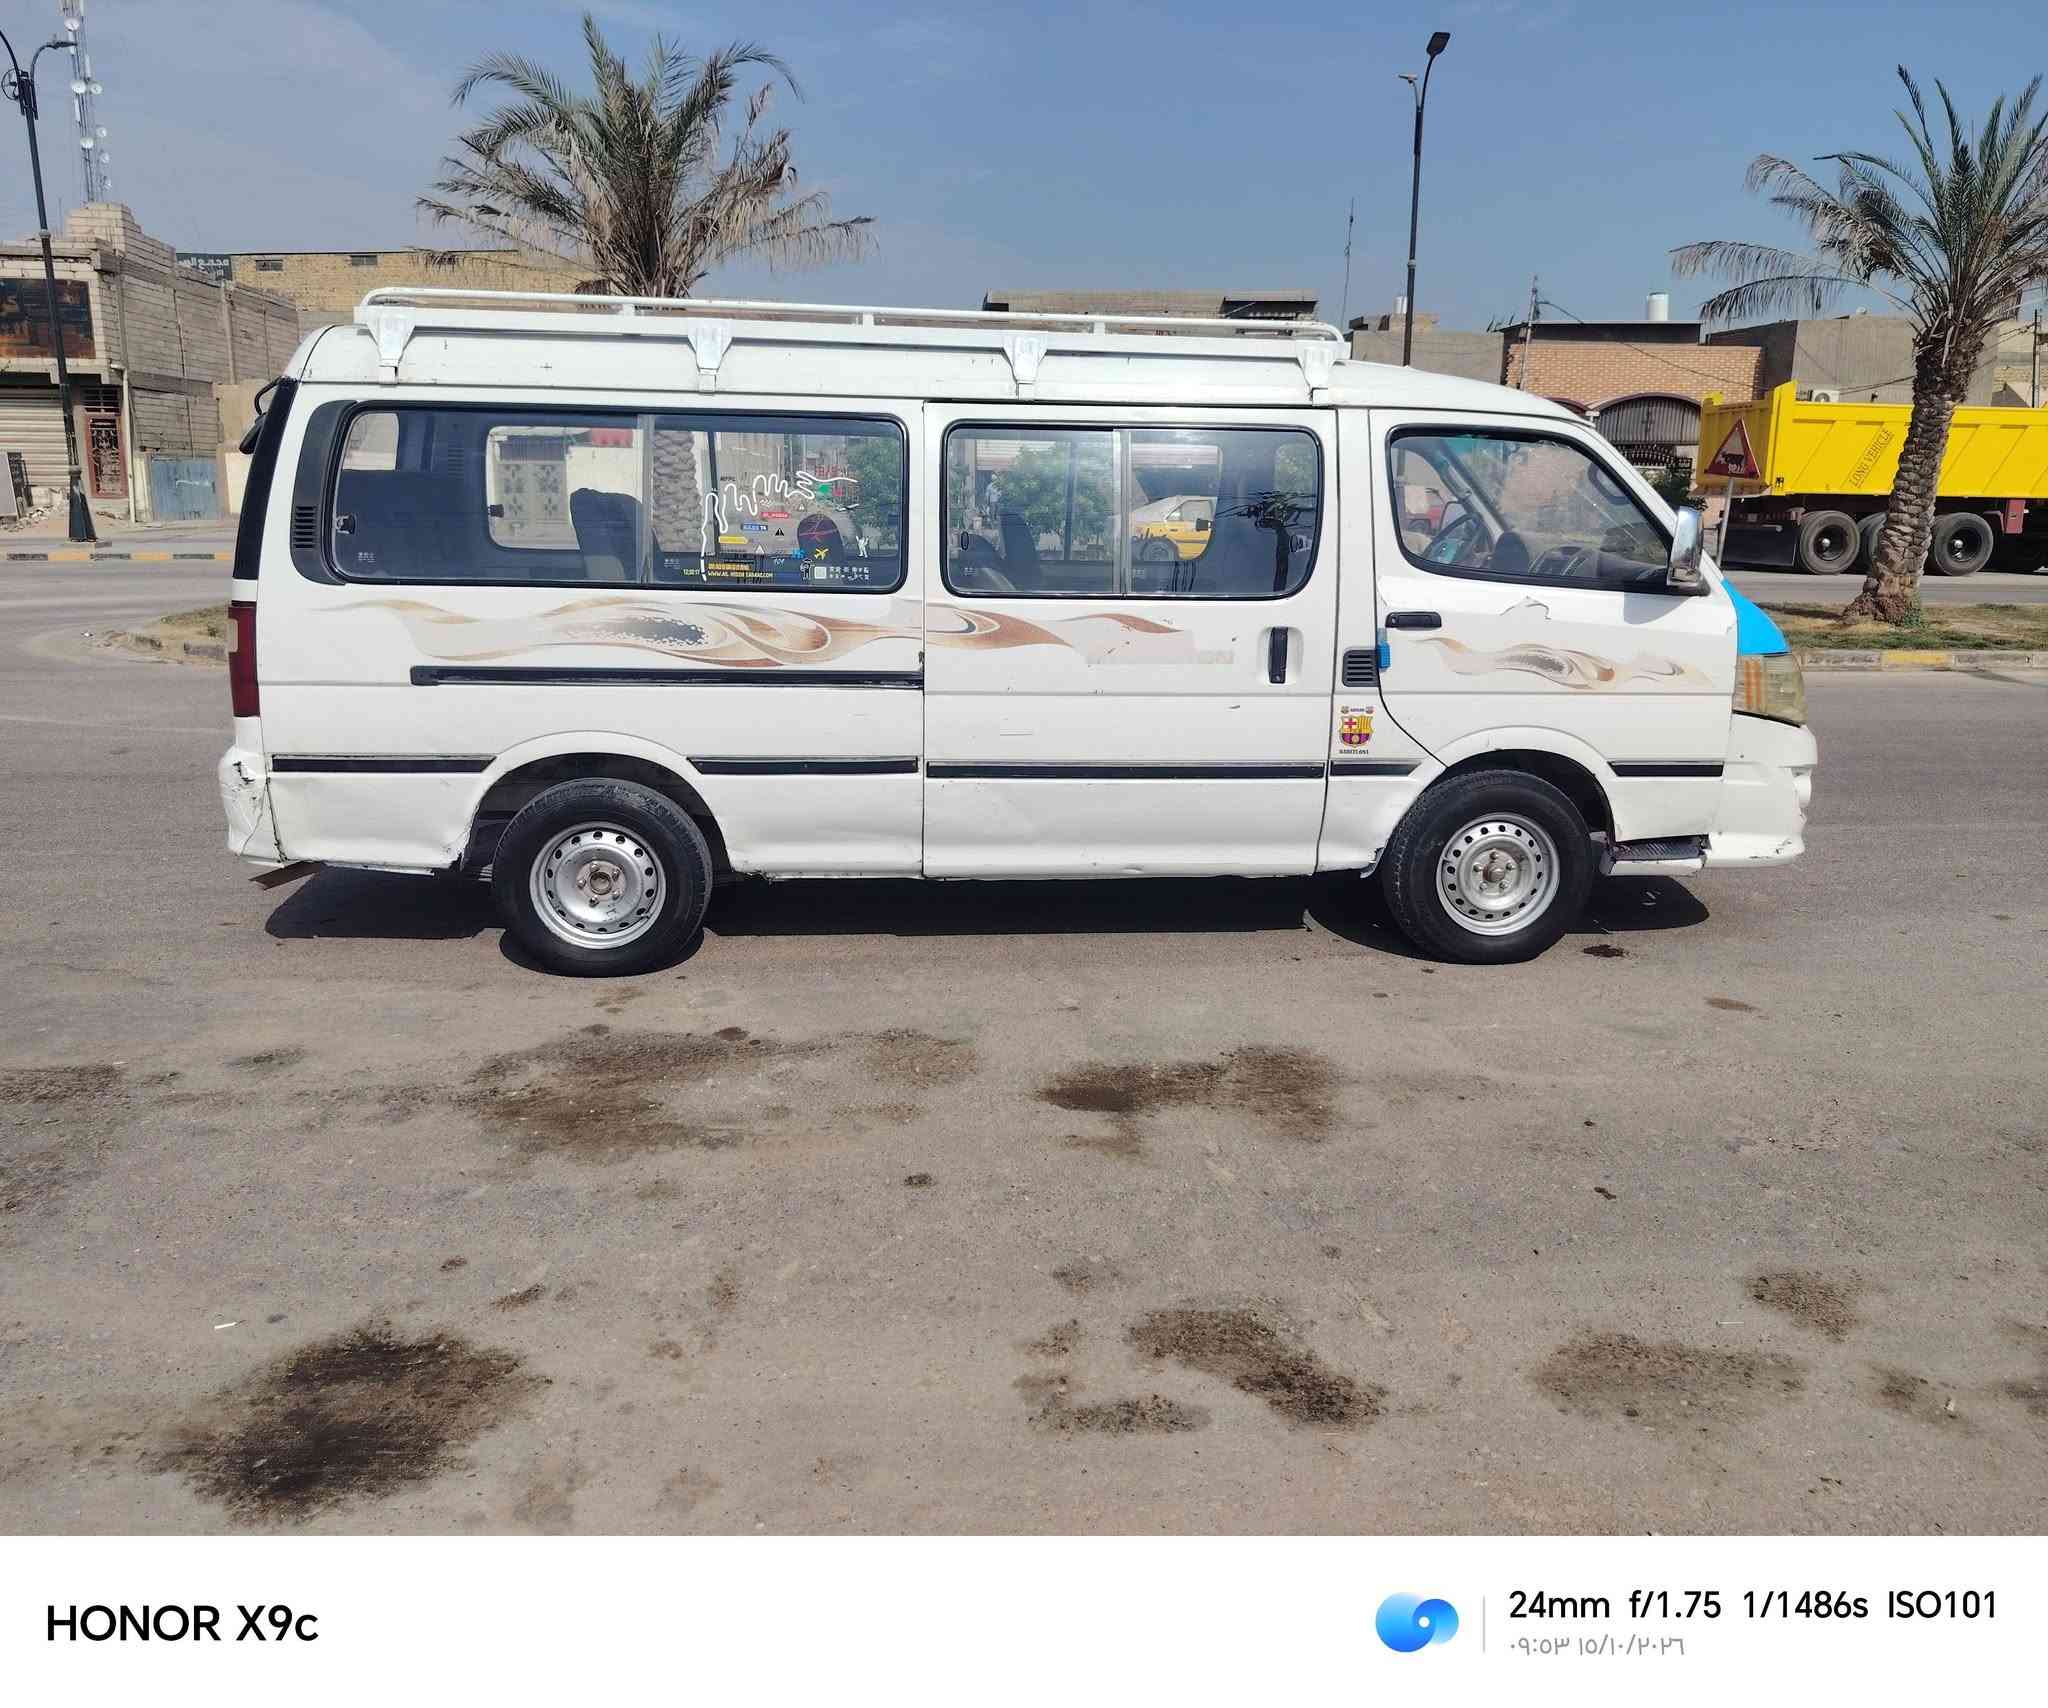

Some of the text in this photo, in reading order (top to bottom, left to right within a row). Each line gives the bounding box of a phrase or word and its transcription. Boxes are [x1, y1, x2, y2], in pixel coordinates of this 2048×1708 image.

[198, 258, 230, 270] مجمع
[1849, 428, 1892, 487] LONG VEHICLE
